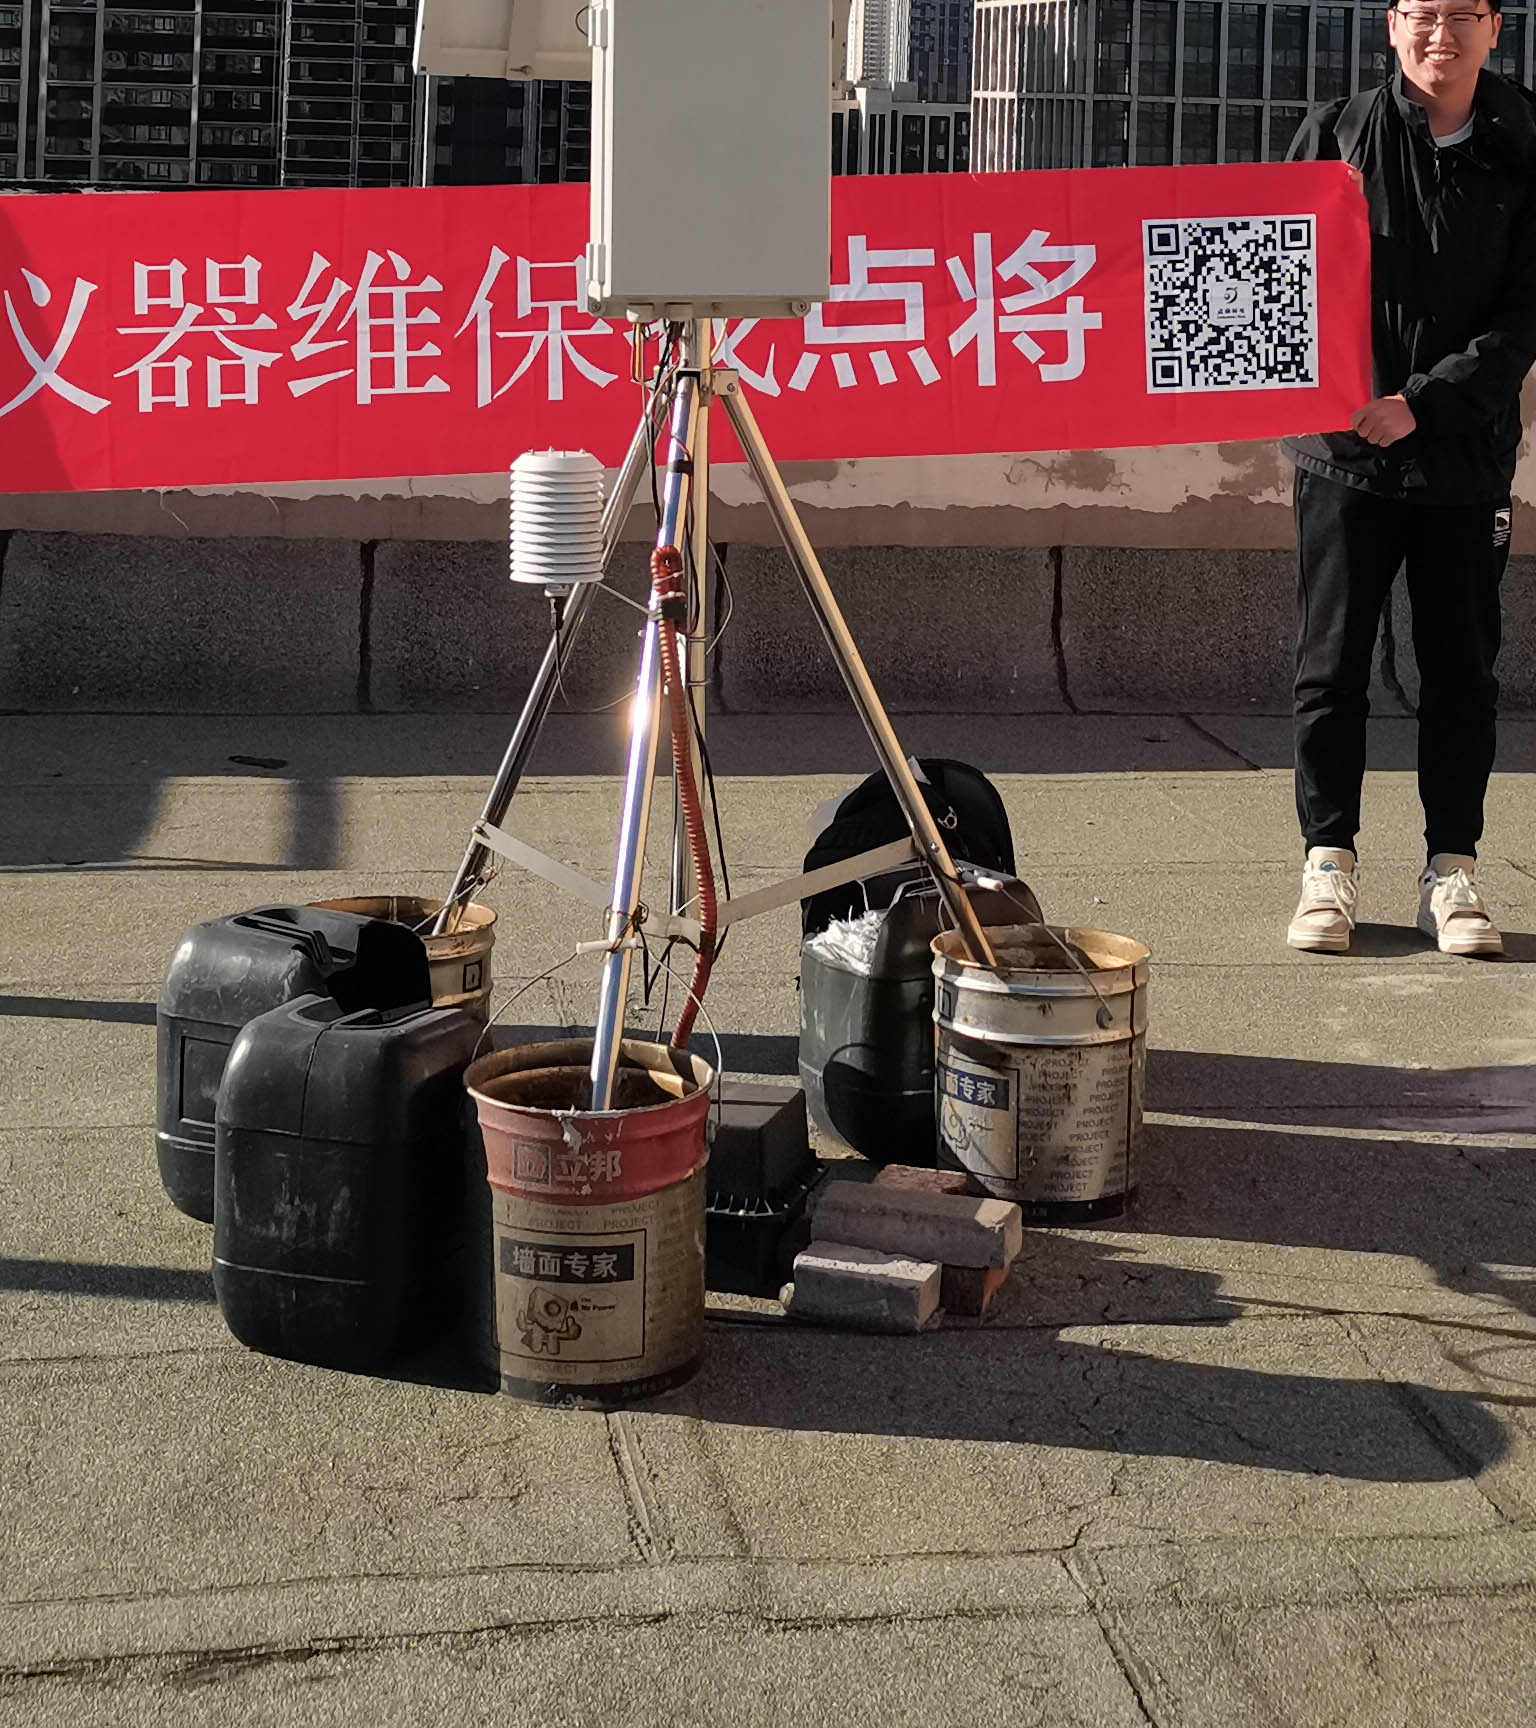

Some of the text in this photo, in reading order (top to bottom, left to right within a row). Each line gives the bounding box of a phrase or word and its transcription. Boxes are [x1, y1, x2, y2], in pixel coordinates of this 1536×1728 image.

[554, 1149, 623, 1184] 立邦
[513, 1245, 618, 1278] 墙面专家
